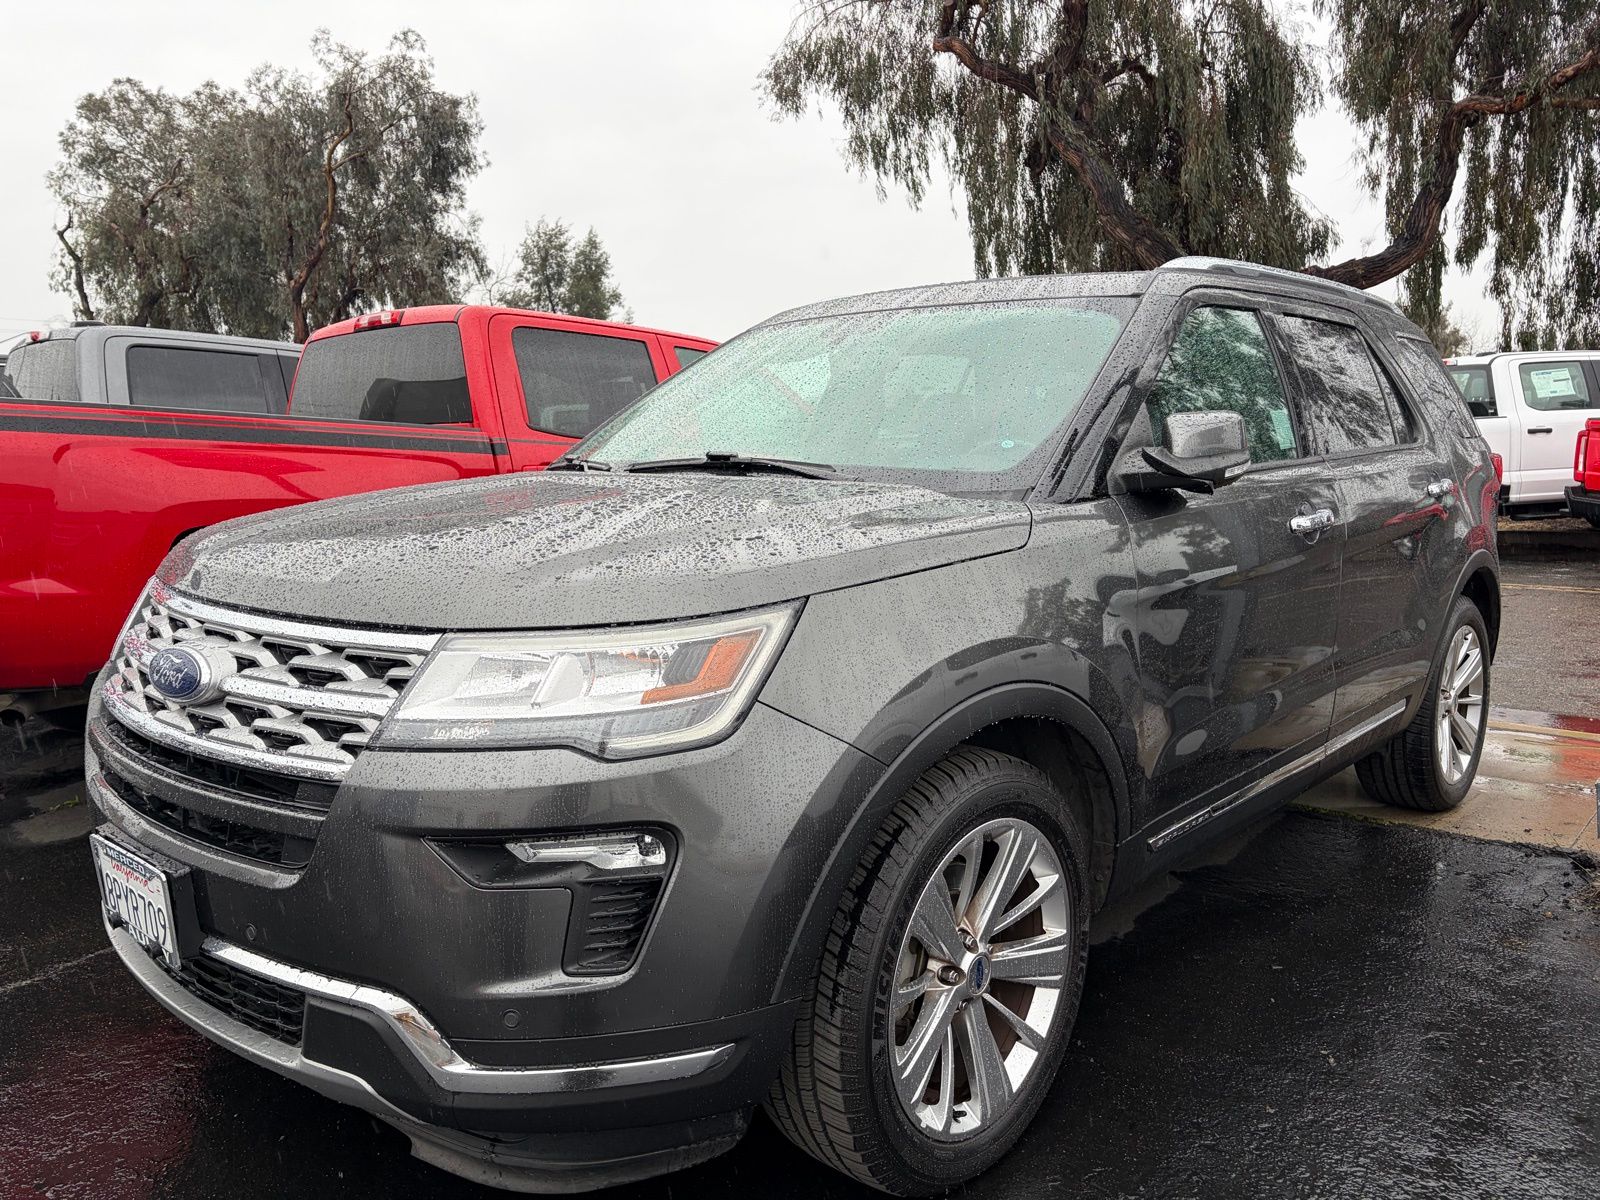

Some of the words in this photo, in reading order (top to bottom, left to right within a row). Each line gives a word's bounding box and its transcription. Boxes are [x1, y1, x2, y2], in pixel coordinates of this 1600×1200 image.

[154, 653, 187, 689] Ford
[106, 846, 145, 876] MERCED
[105, 872, 167, 946] 8PYR709
